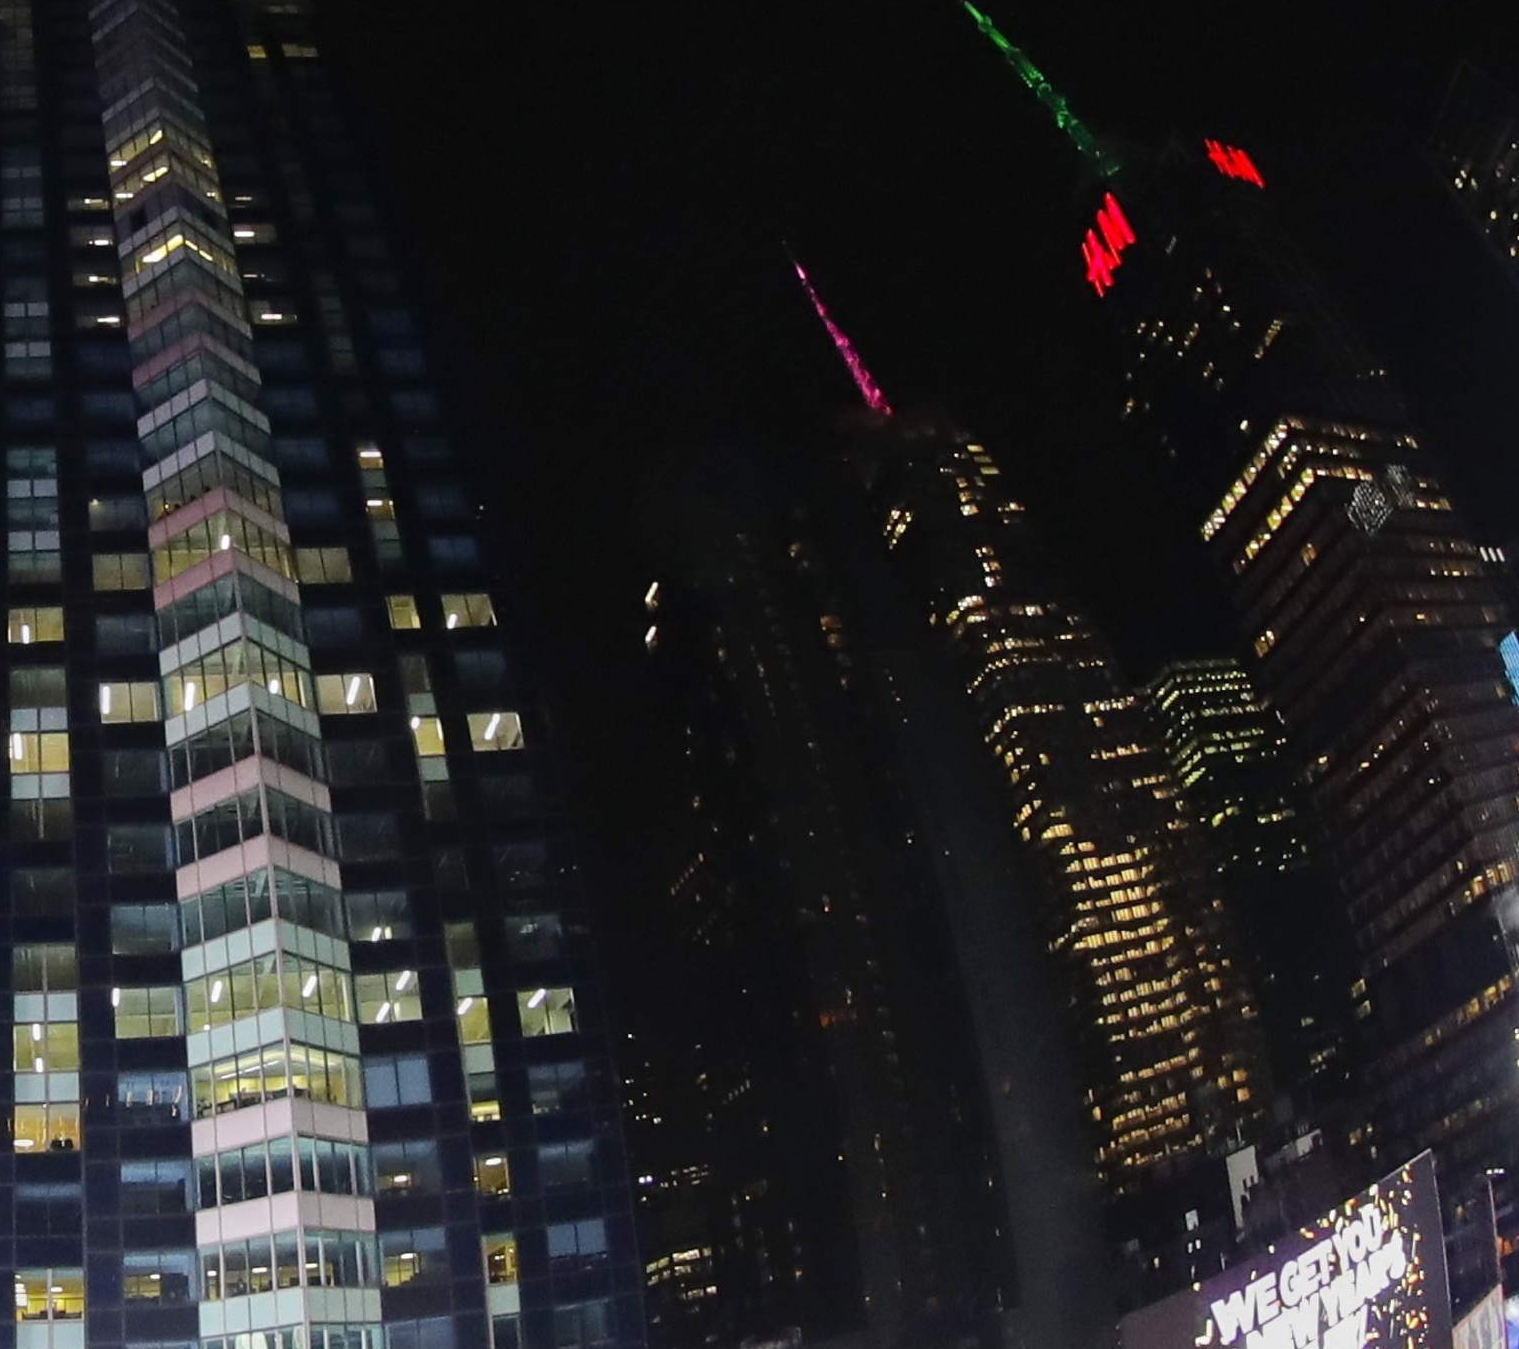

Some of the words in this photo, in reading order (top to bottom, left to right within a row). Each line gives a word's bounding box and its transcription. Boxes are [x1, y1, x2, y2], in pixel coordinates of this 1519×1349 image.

[1211, 1272, 1279, 1345] WE
[1280, 1239, 1333, 1307] GET
[1332, 1203, 1384, 1275] YOU
